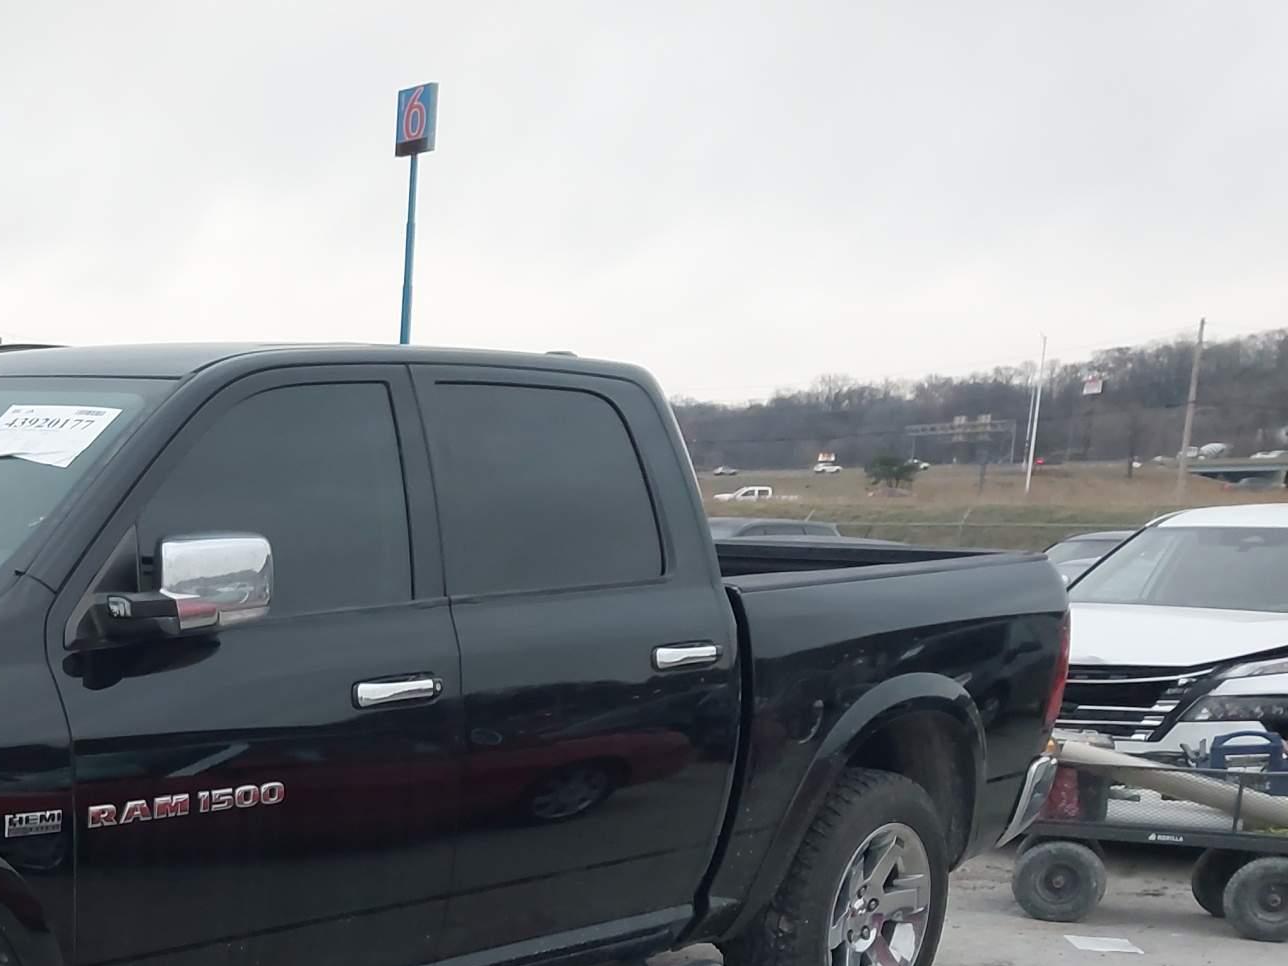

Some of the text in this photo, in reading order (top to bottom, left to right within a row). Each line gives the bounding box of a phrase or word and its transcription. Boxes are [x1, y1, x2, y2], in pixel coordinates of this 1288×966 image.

[403, 86, 426, 140] 6
[5, 417, 95, 430] 43920177
[8, 811, 62, 827] HEMI
[87, 781, 285, 828] RAM 1500
